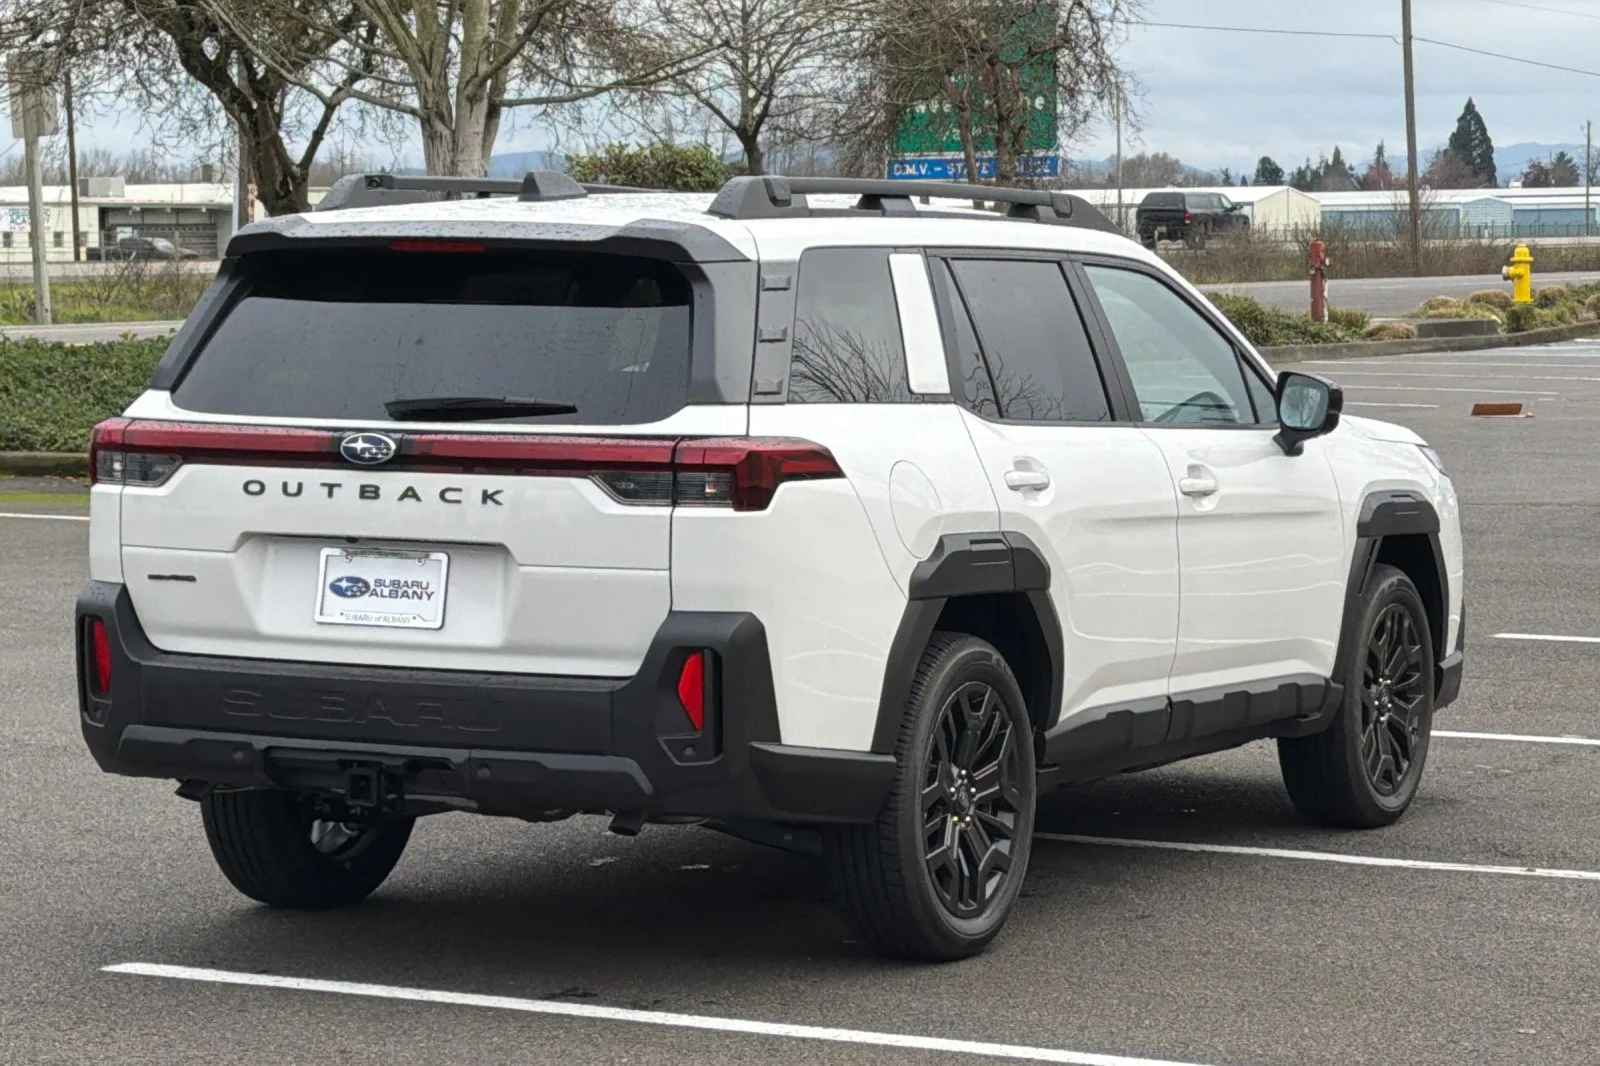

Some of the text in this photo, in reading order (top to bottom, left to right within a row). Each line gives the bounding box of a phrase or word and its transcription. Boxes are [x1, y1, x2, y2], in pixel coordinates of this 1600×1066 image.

[242, 479, 505, 506] OUTBACK
[373, 578, 430, 590] SUBARU
[368, 588, 436, 601] ALBANY
[343, 612, 373, 622] SUBARU
[382, 615, 411, 624] ALBANY
